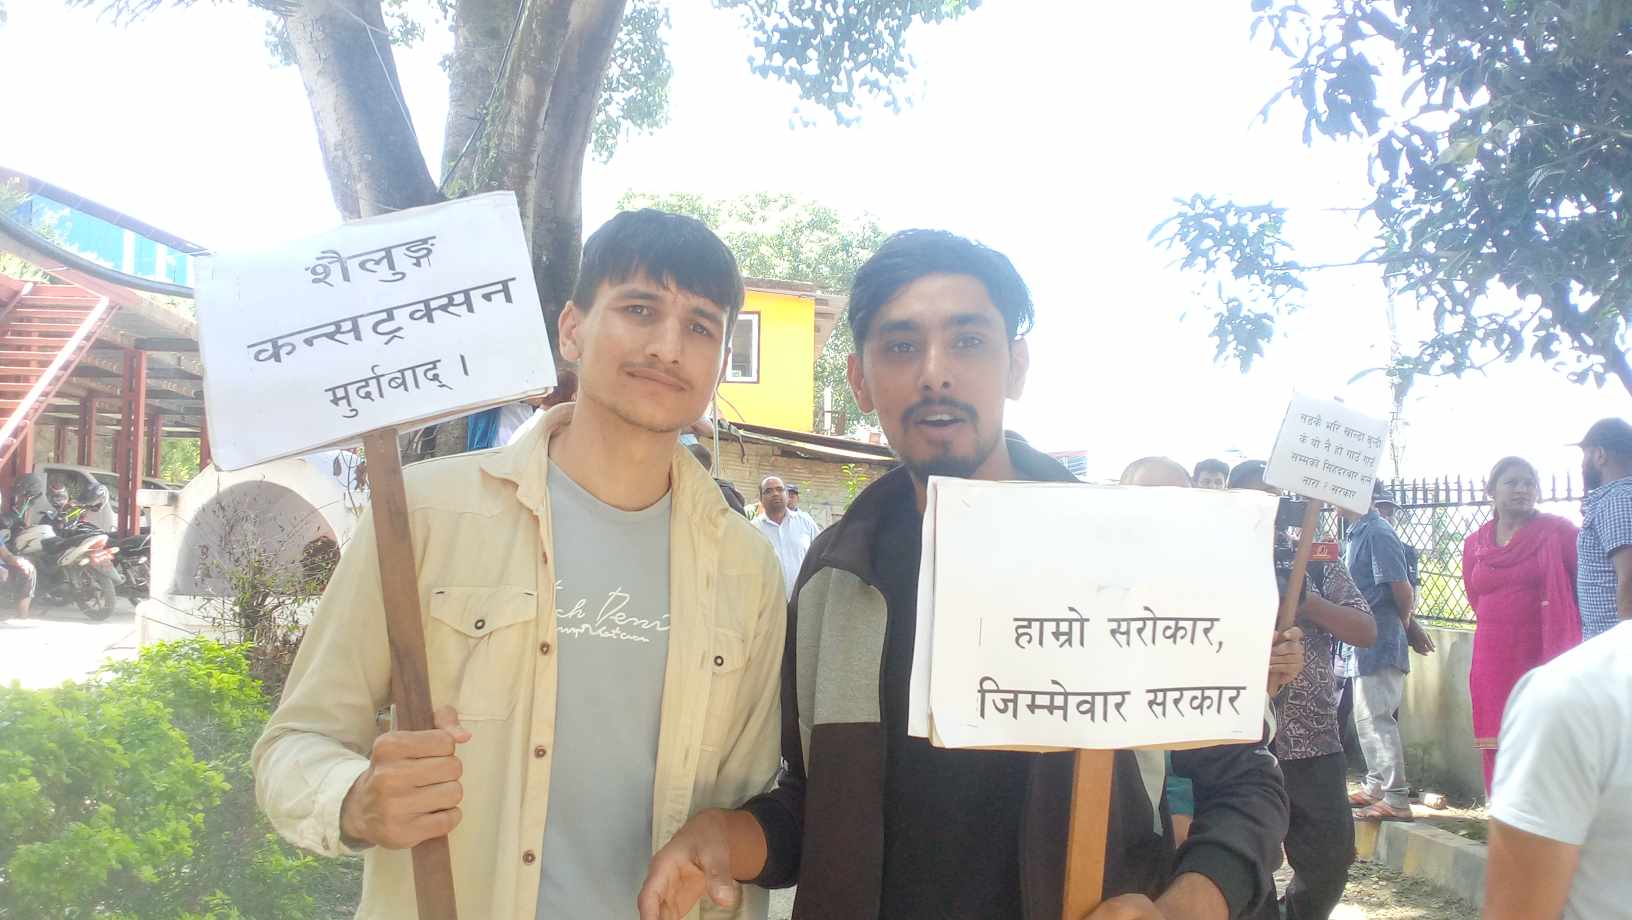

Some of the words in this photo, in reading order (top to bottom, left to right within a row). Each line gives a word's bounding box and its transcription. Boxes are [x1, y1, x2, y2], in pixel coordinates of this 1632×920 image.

[247, 276, 517, 363] कन्सट्रक्सन
[1013, 605, 1090, 649] हाम्रो
[1107, 605, 1223, 653] सरोकार,
[977, 675, 1131, 723] जिम्मेवार
[1145, 686, 1248, 718] सरकार
